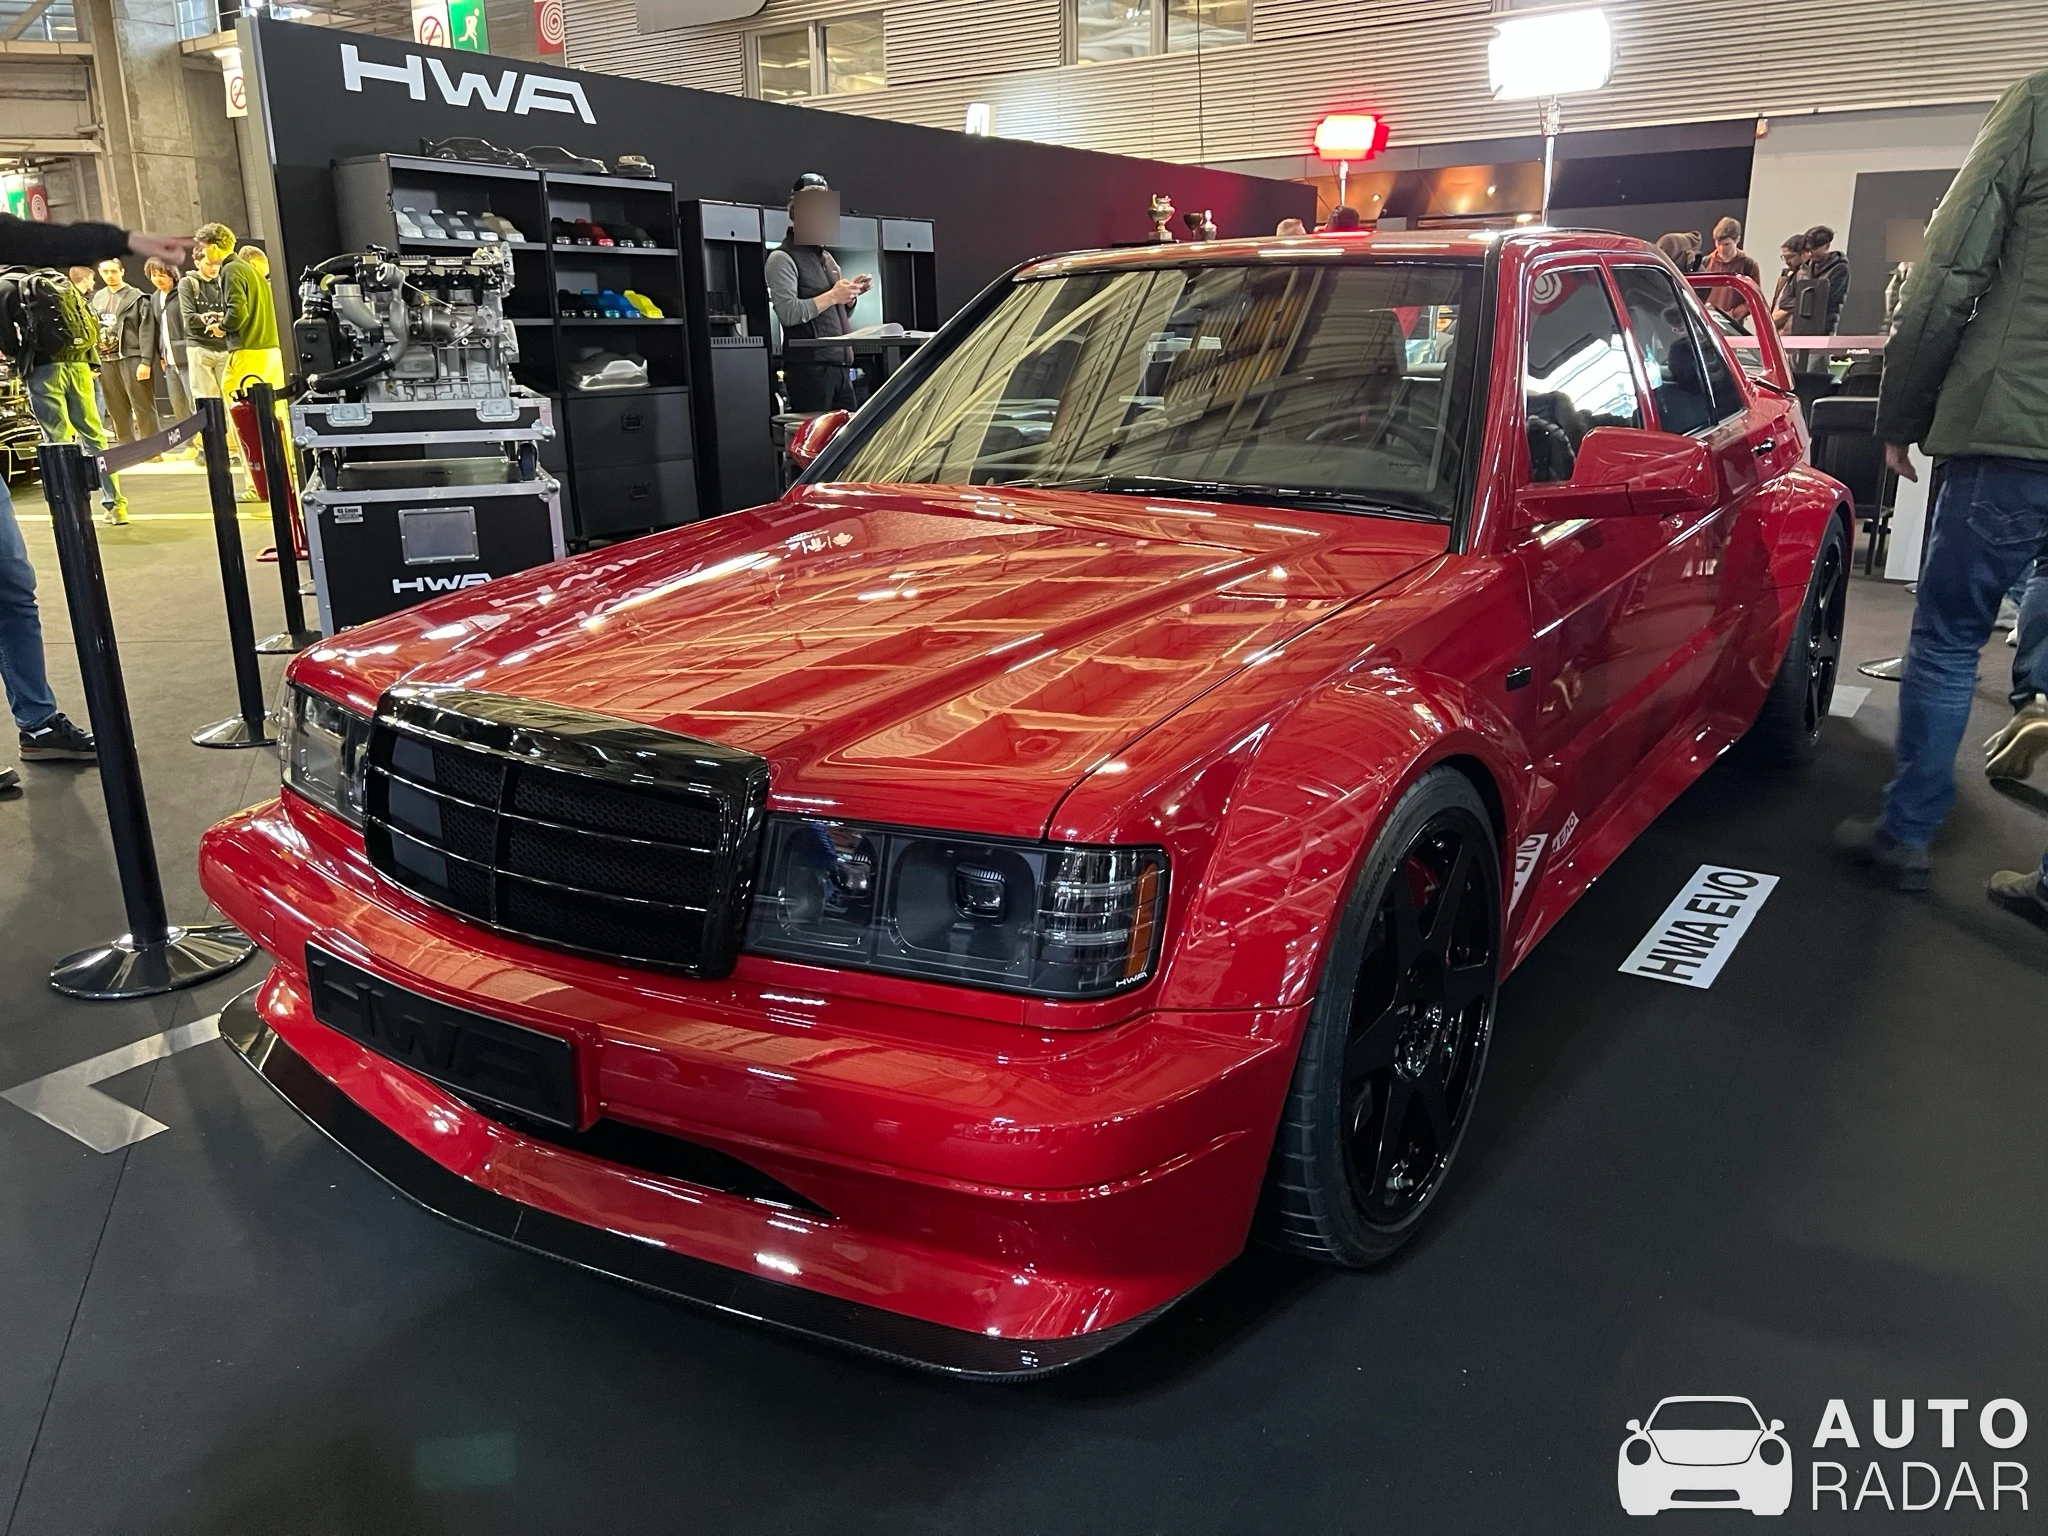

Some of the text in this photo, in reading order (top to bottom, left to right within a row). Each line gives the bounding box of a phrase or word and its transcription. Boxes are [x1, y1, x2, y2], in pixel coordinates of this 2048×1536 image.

[340, 43, 597, 125] HWA
[392, 572, 492, 594] HWA
[1637, 871, 1760, 981] HWA EVO
[1115, 971, 1148, 988] HWA
[311, 960, 563, 1110] HWA
